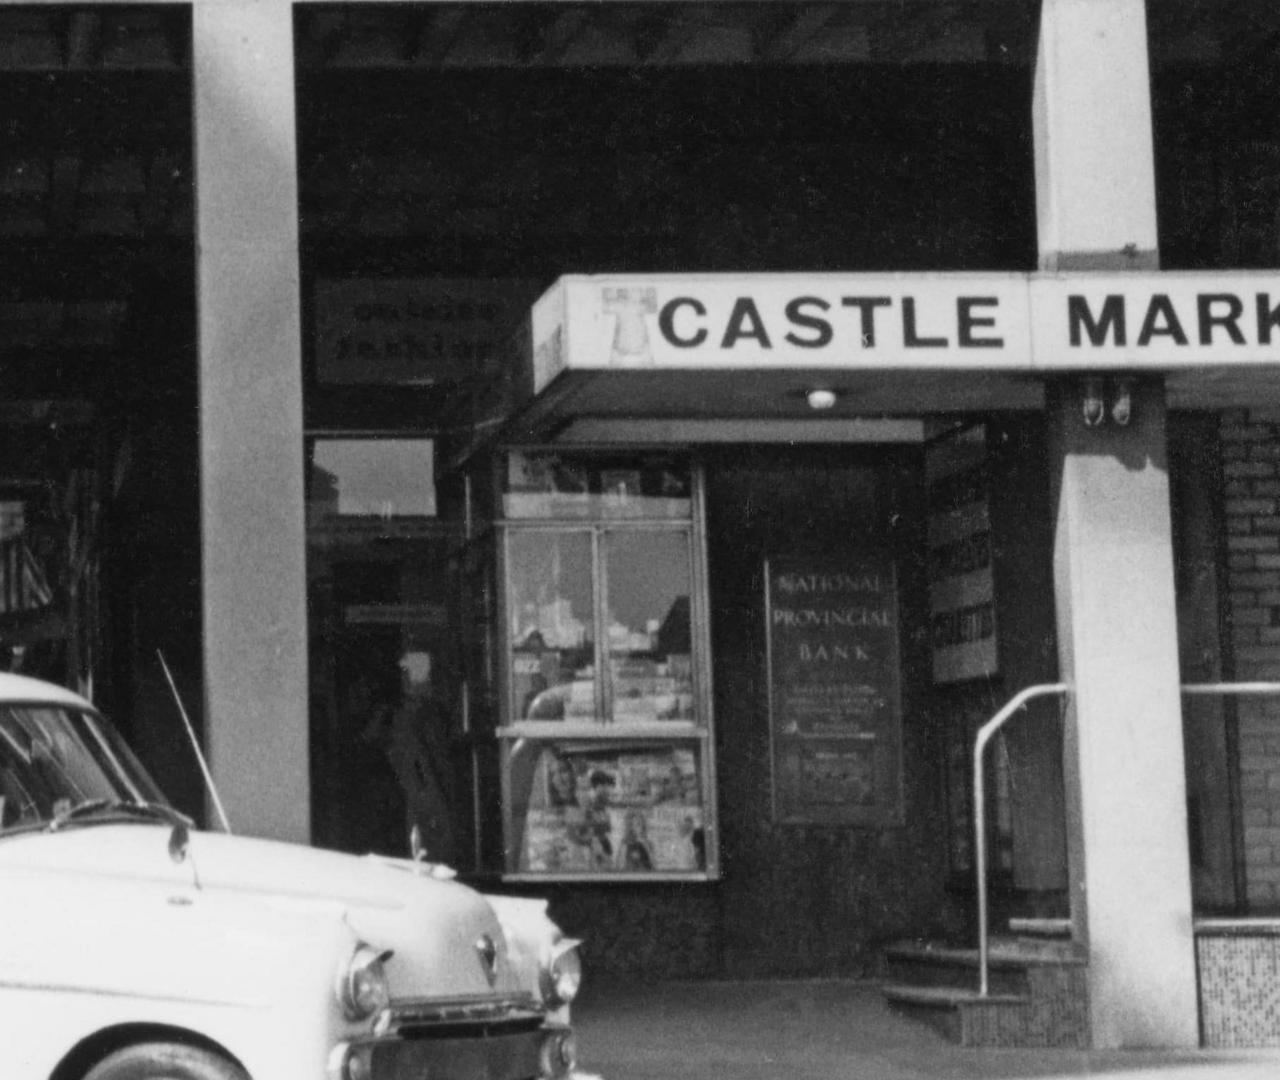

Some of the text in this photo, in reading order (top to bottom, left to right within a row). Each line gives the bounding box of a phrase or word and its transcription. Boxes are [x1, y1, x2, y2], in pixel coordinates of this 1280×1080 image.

[657, 295, 1006, 349] CASTLE
[777, 575, 880, 592] NATIONAL
[773, 609, 890, 627] PROVINCIAL
[799, 644, 869, 661] BANK
